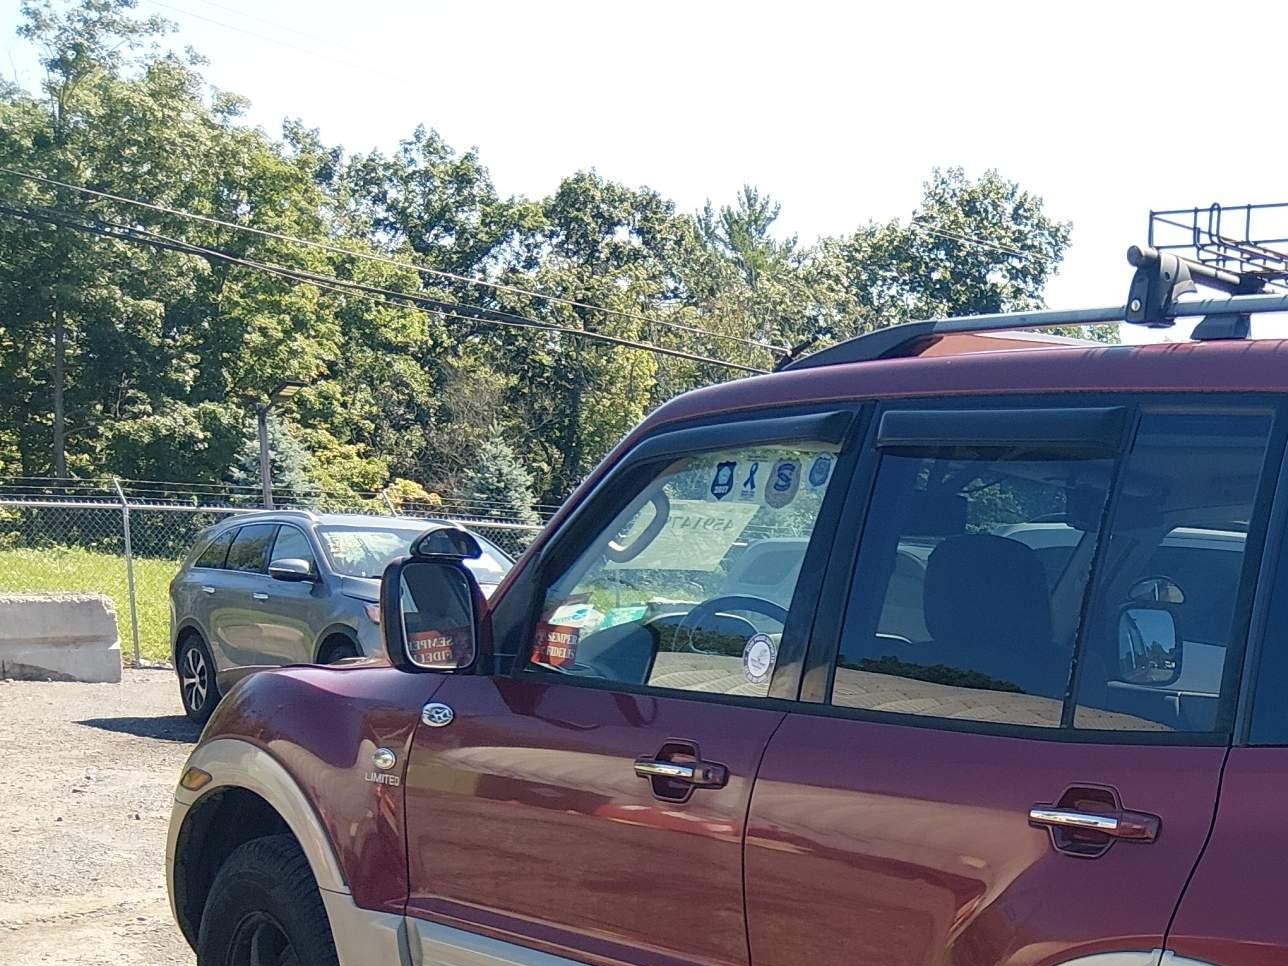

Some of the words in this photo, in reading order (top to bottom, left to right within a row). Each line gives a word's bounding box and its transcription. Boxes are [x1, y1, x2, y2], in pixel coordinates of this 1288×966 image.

[548, 631, 578, 645] SEMPER
[547, 645, 576, 658] FIDELIS
[364, 772, 400, 787] LIMITED
